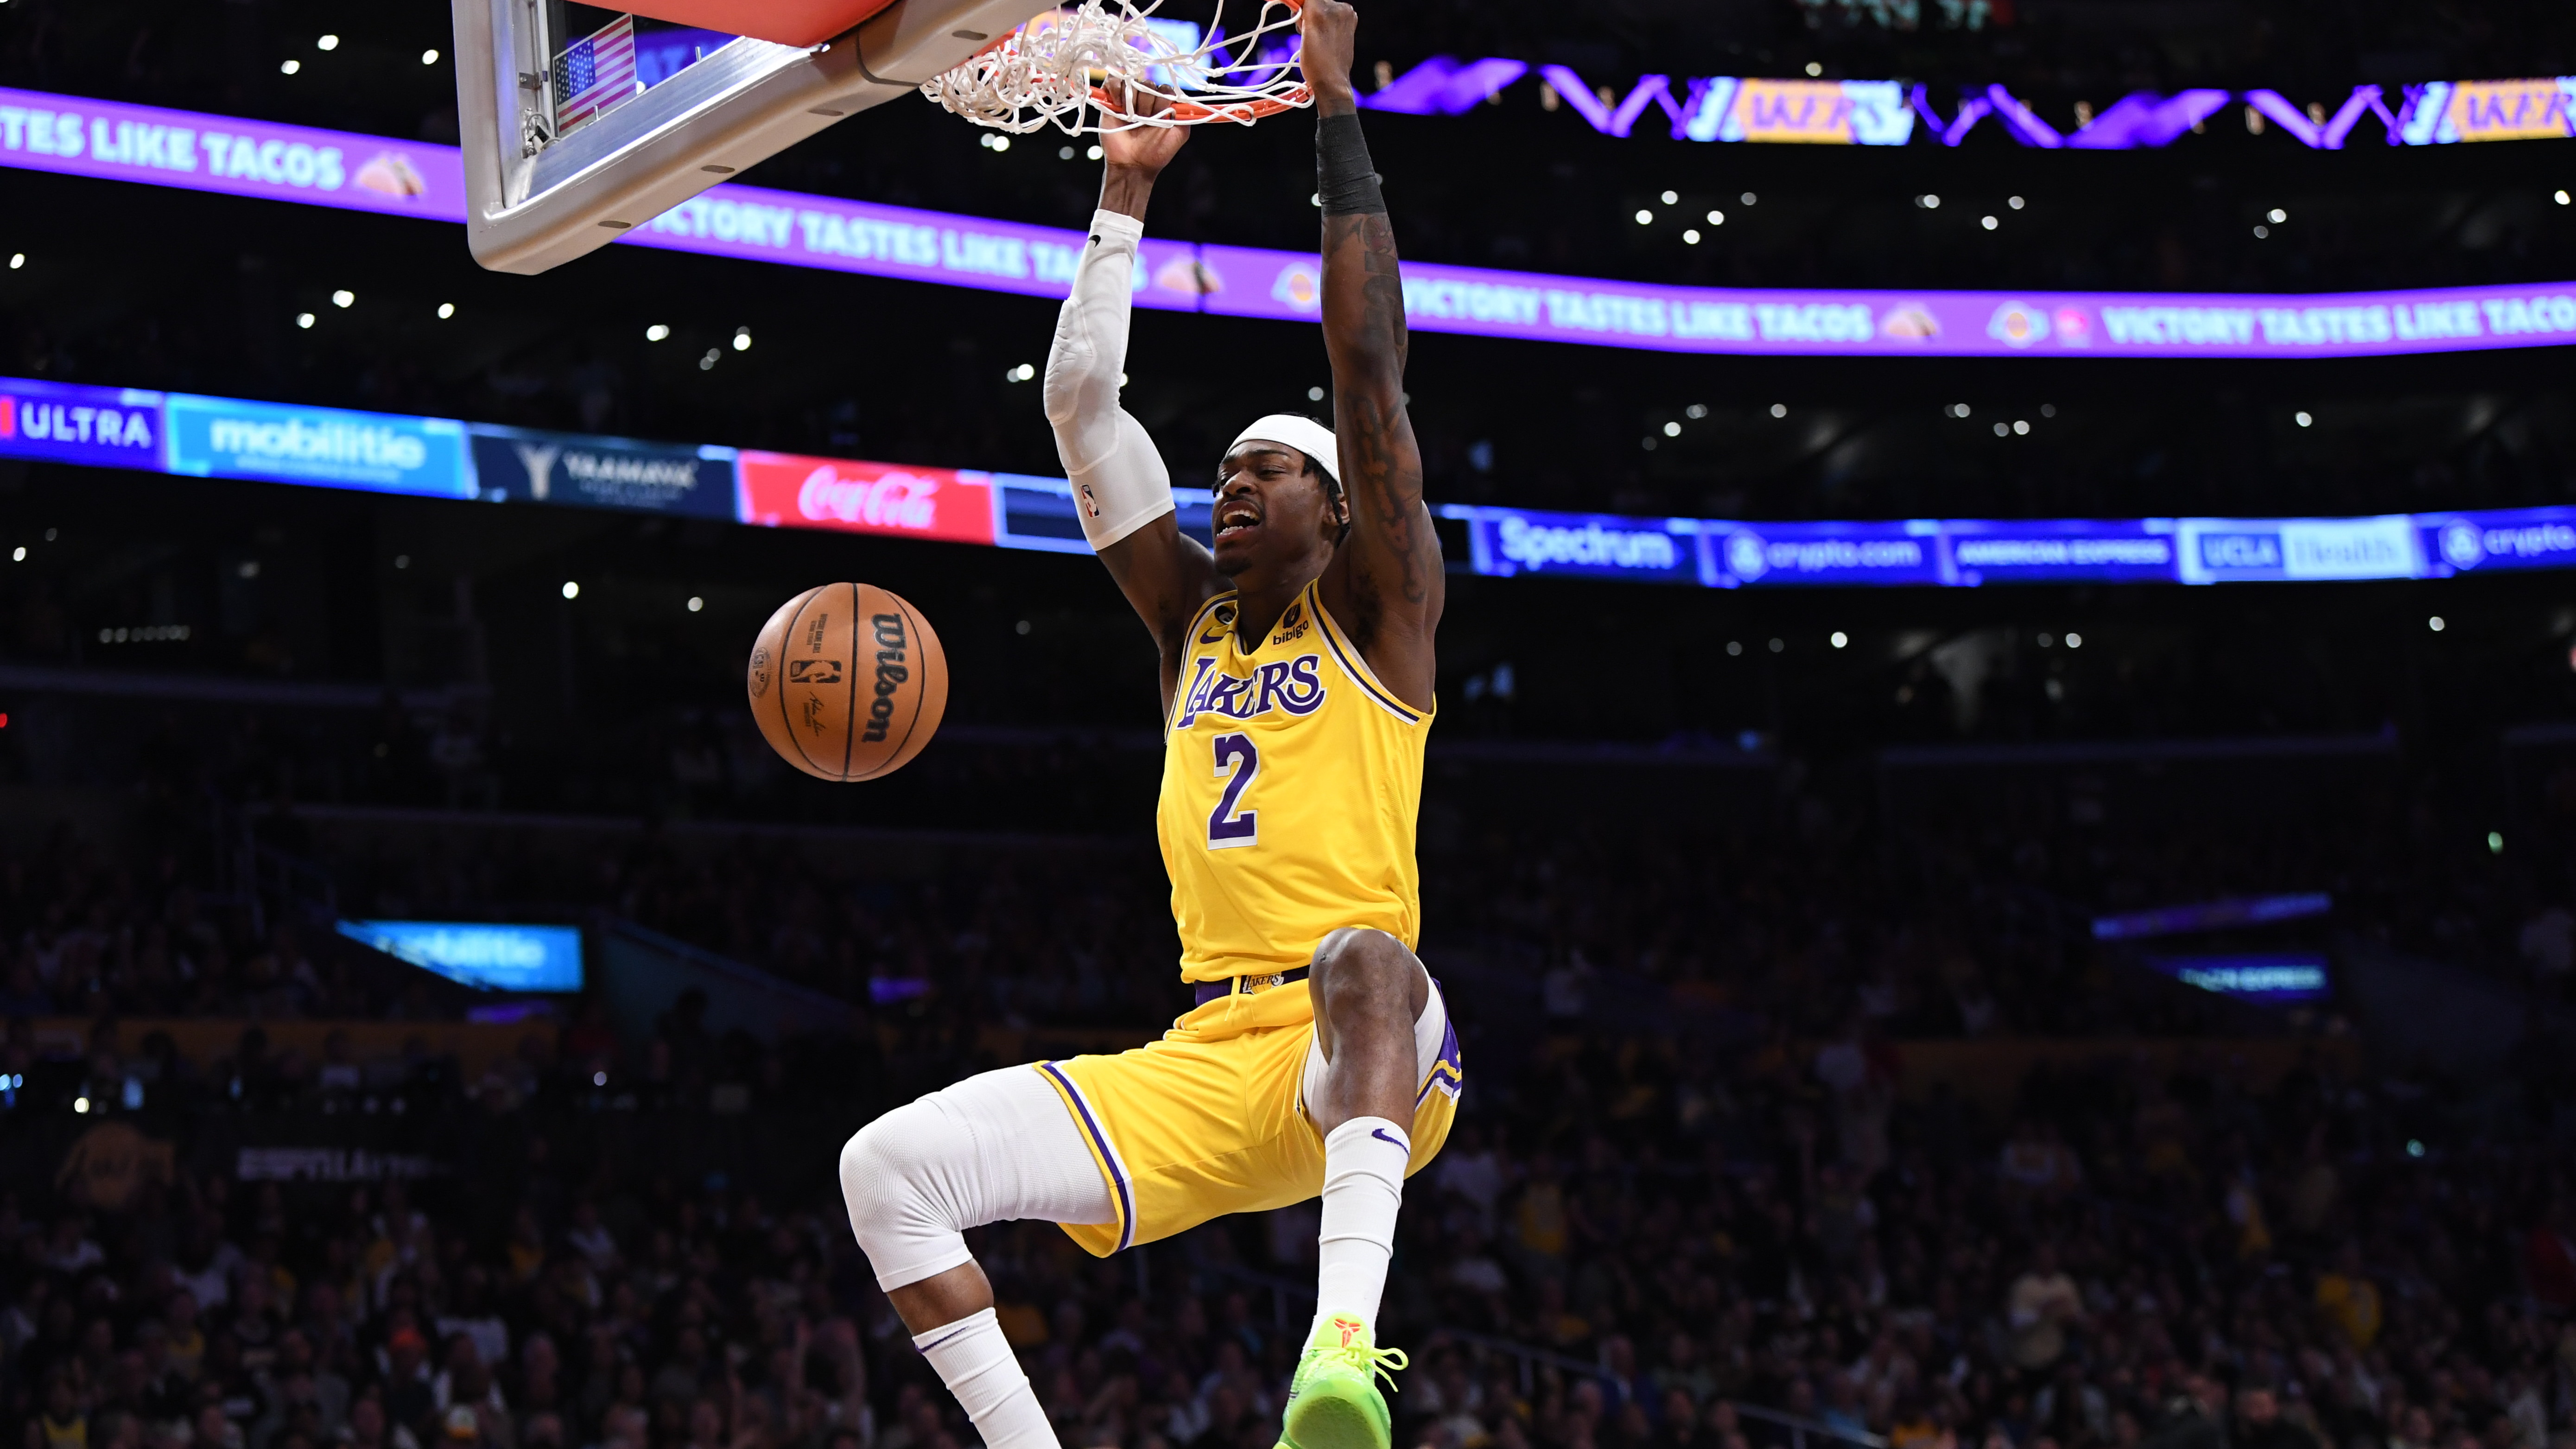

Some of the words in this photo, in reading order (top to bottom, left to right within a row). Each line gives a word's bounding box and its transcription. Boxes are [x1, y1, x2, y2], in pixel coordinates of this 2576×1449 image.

[0, 105, 84, 158] TES
[91, 117, 197, 172] LIKE
[201, 131, 346, 191] TACOS
[797, 210, 938, 267] TASTES
[941, 229, 1027, 279] LIKE
[1544, 288, 1667, 337] TASTES
[1669, 300, 1753, 341] LIKE
[1756, 303, 1872, 342] TACOS
[2100, 306, 2254, 345] VICTORY
[2256, 304, 2392, 345] TASTES
[2393, 299, 2482, 341] LIKE
[21, 402, 152, 448] ULTRA
[210, 417, 425, 470] mobilitie
[797, 465, 941, 529] Coca-Cola
[1499, 516, 1675, 571] Spectrum
[1766, 539, 1922, 572] crypto.com
[1957, 540, 2067, 566] AMERICAN
[2068, 538, 2170, 565] EXPRESS
[2203, 536, 2280, 567] UCLA
[1273, 620, 1309, 646] bibigo
[862, 612, 909, 743] Wilson
[1175, 653, 1327, 730] LAKERS
[1207, 731, 1260, 850] 2
[1244, 973, 1283, 991] LAKERS
